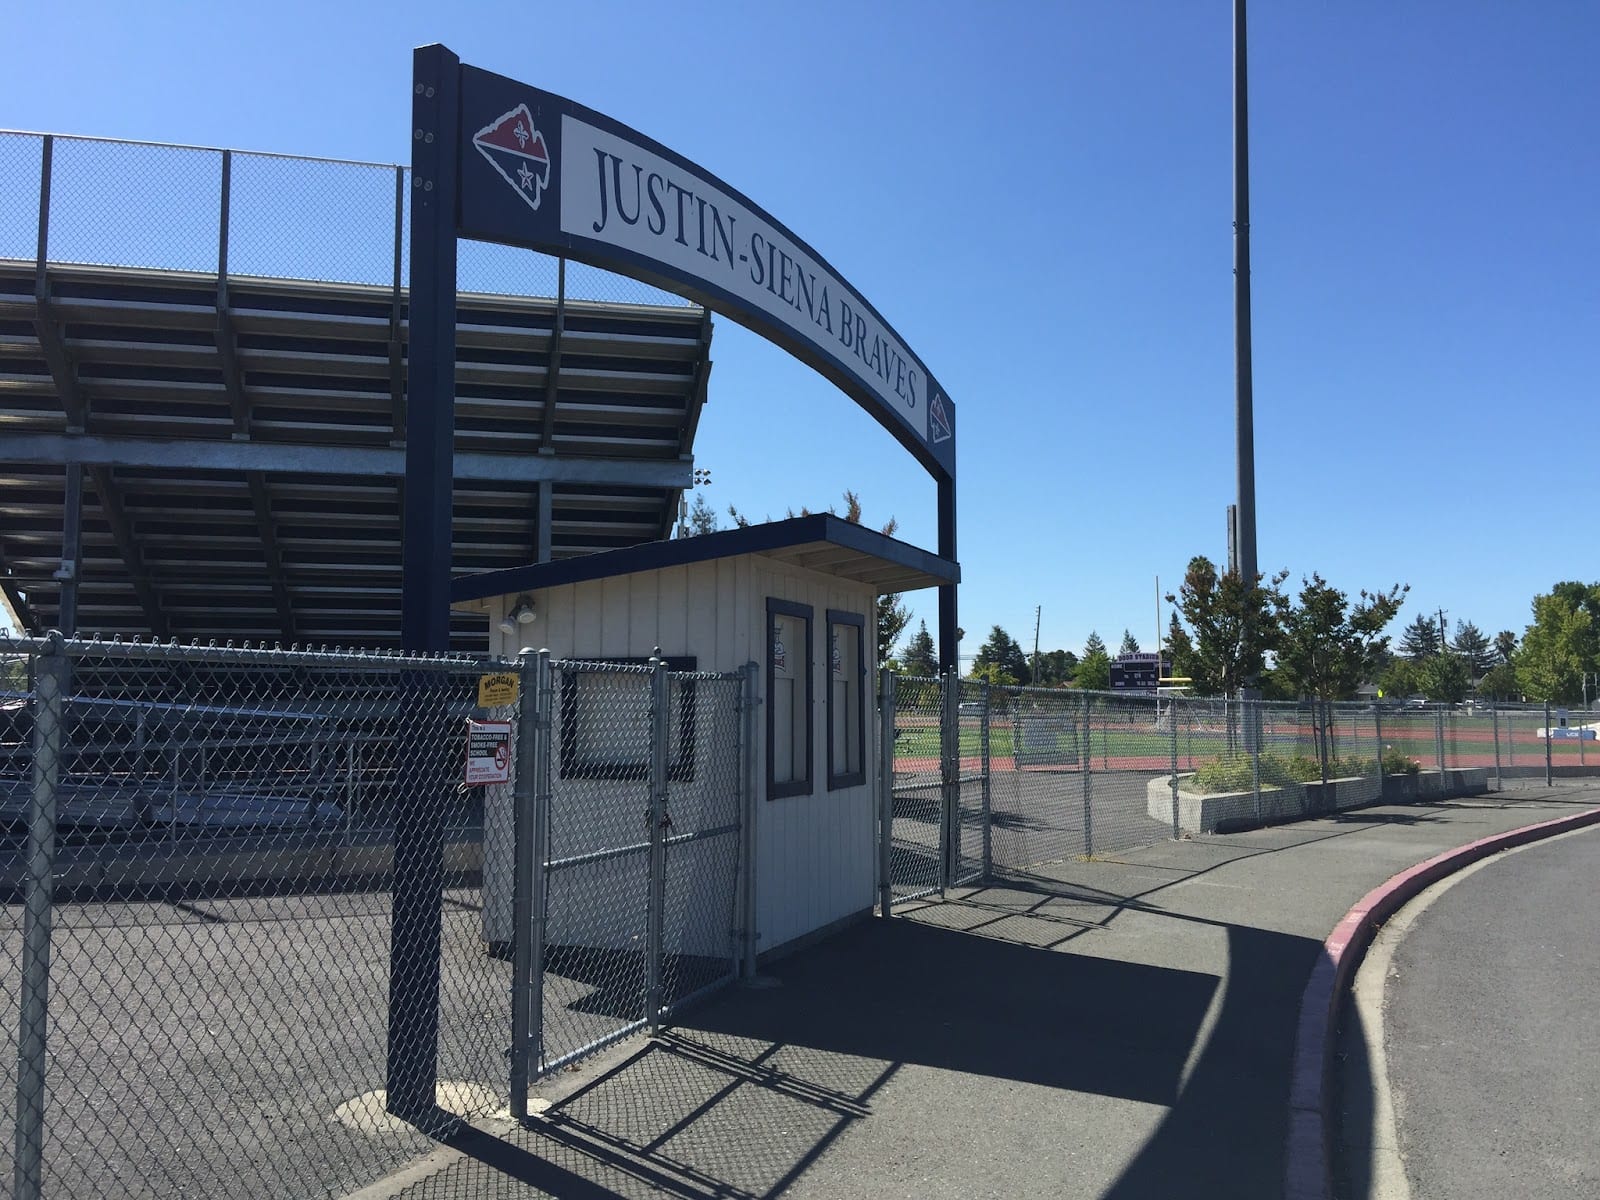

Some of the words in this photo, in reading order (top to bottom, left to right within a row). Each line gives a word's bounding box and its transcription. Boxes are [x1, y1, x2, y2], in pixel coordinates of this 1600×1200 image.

[593, 147, 834, 336] JUSTIN-SIENA
[839, 301, 917, 409] BRAVES
[484, 676, 515, 690] MORGAN
[471, 733, 503, 741] TOBACCO-FREE
[470, 741, 499, 749] SMOKE-FREE
[470, 749, 488, 757] SCHOOL
